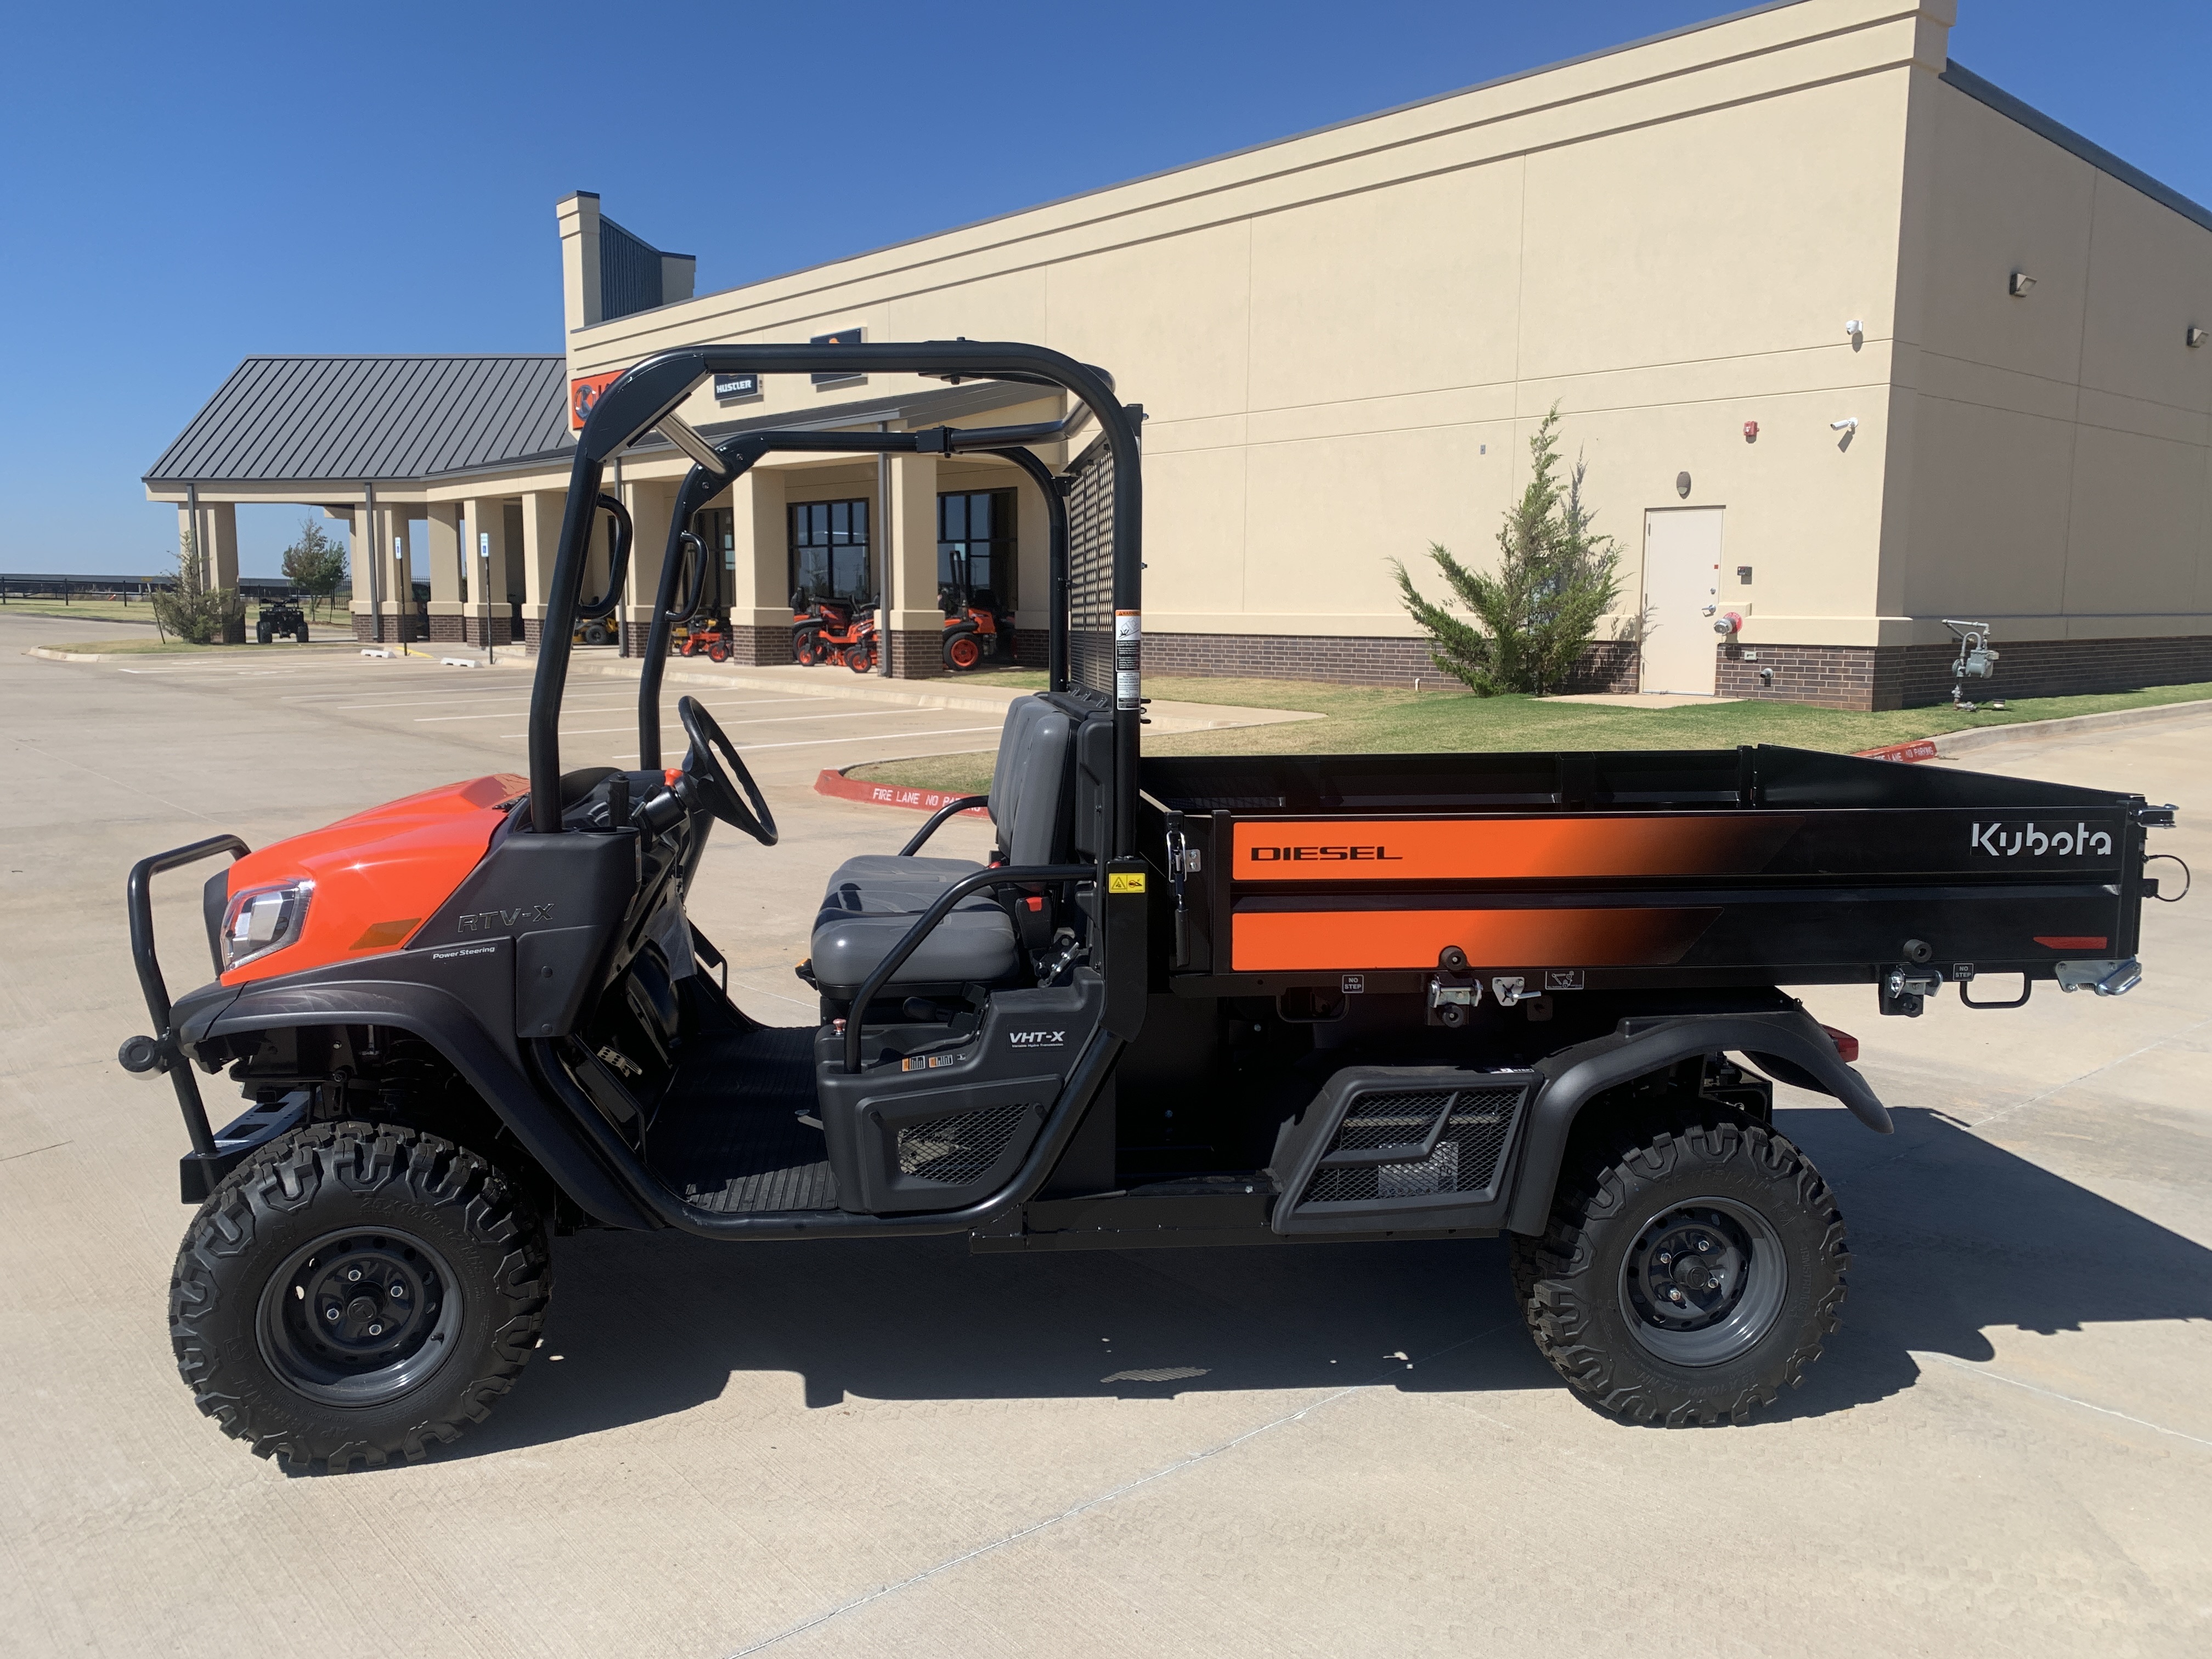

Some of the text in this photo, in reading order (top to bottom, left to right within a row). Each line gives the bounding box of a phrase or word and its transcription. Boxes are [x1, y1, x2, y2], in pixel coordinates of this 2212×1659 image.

[716, 380, 752, 393] HUSTLER
[1914, 747, 1934, 757] PARKING
[872, 788, 893, 801] FIRE
[896, 791, 921, 804] LANE
[925, 794, 939, 806] NO
[1972, 822, 2112, 856] Kubota
[1251, 847, 1403, 861] DIESEL
[458, 903, 555, 933] RTV-X
[432, 947, 495, 960] Power Steering
[1009, 1031, 1065, 1043] VHT-X
